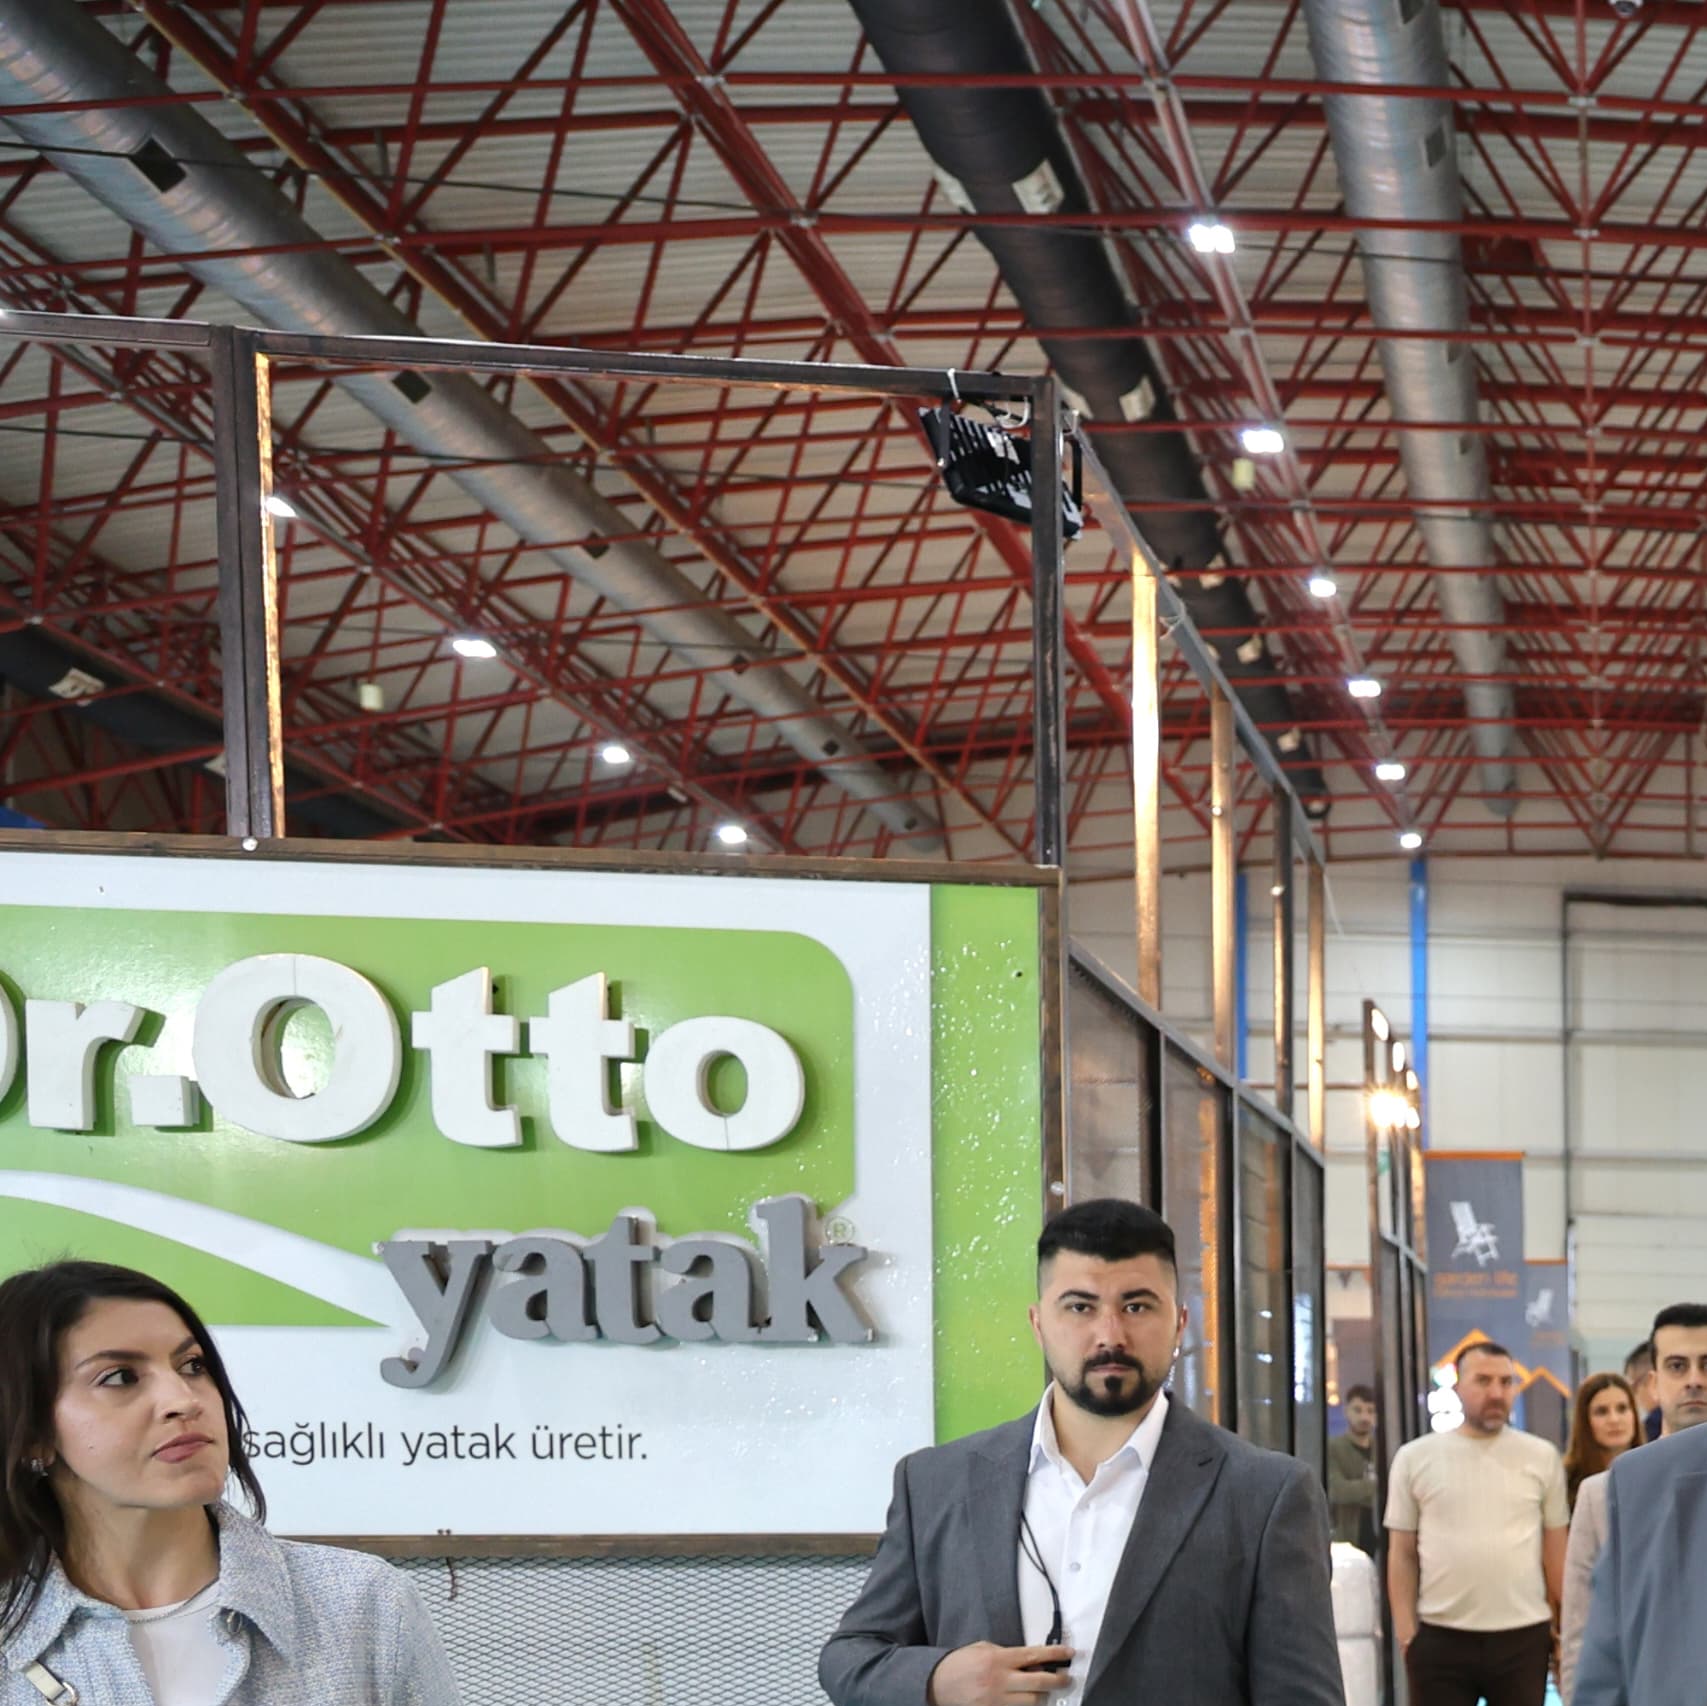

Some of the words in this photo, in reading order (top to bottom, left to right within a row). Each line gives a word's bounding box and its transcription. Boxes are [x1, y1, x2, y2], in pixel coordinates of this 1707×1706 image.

[0, 953, 806, 1153] r.Otto
[380, 1194, 878, 1391] yatak
[242, 1421, 385, 1465] sağlıklı
[400, 1422, 517, 1466] yatak
[531, 1423, 648, 1460] üretir.
